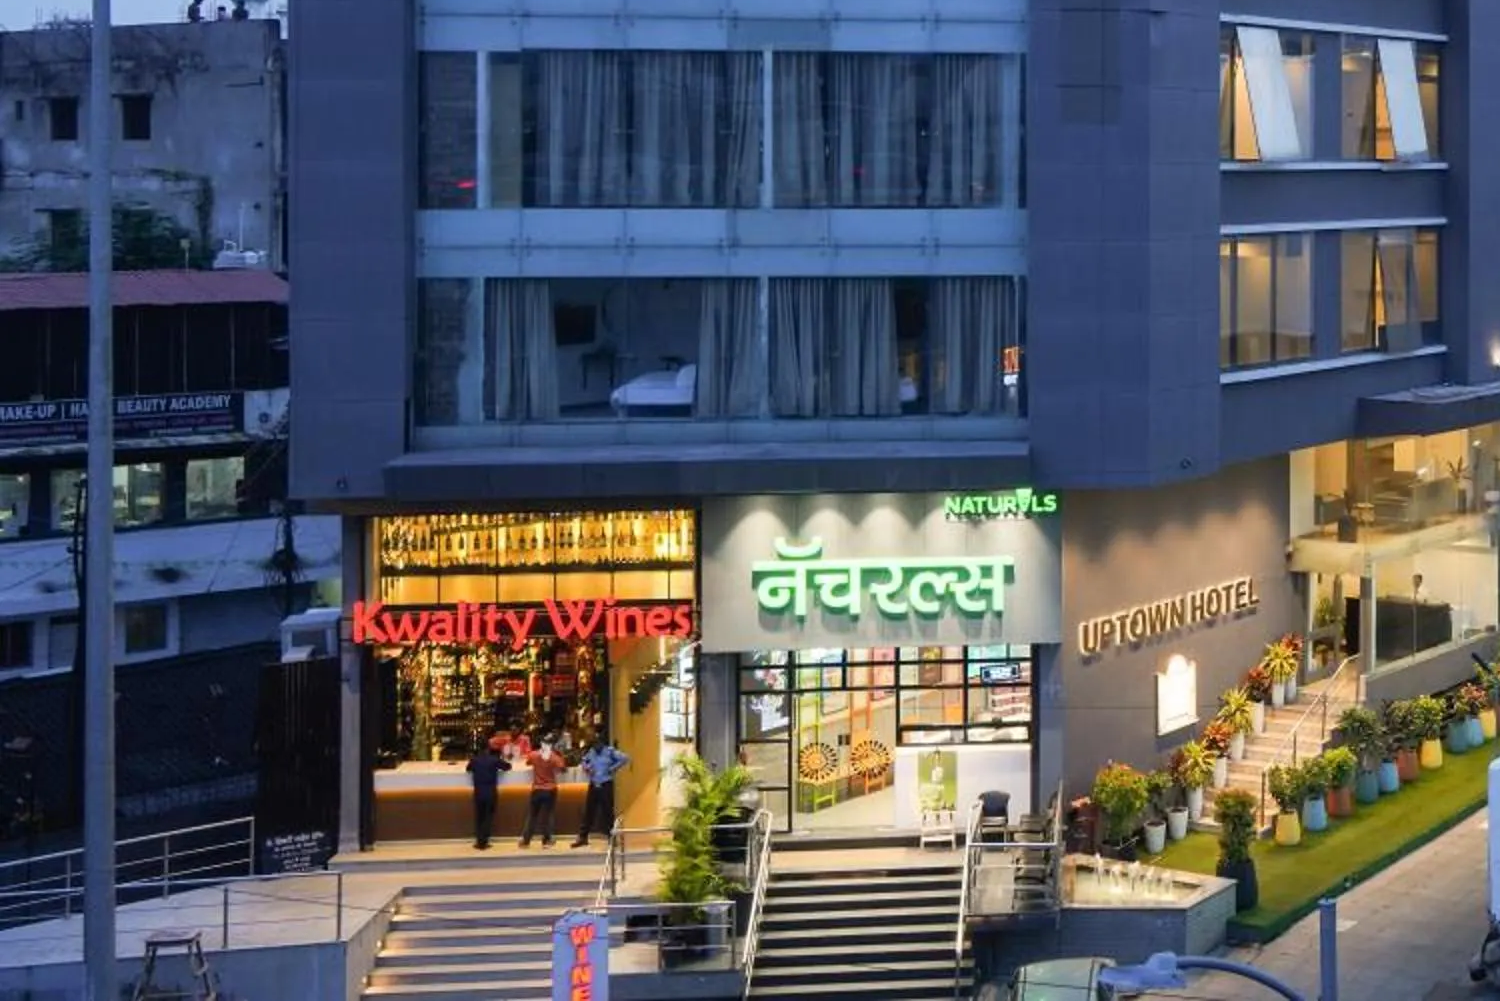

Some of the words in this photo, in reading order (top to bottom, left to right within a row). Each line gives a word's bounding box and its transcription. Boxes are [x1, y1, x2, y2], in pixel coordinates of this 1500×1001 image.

[117, 398, 167, 414] BEAUTY
[168, 394, 232, 411] ACADEMY
[351, 599, 538, 650] Kwality
[544, 597, 694, 639] Wines
[1079, 596, 1186, 656] UPTOWN
[1188, 576, 1261, 624] HOTEL
